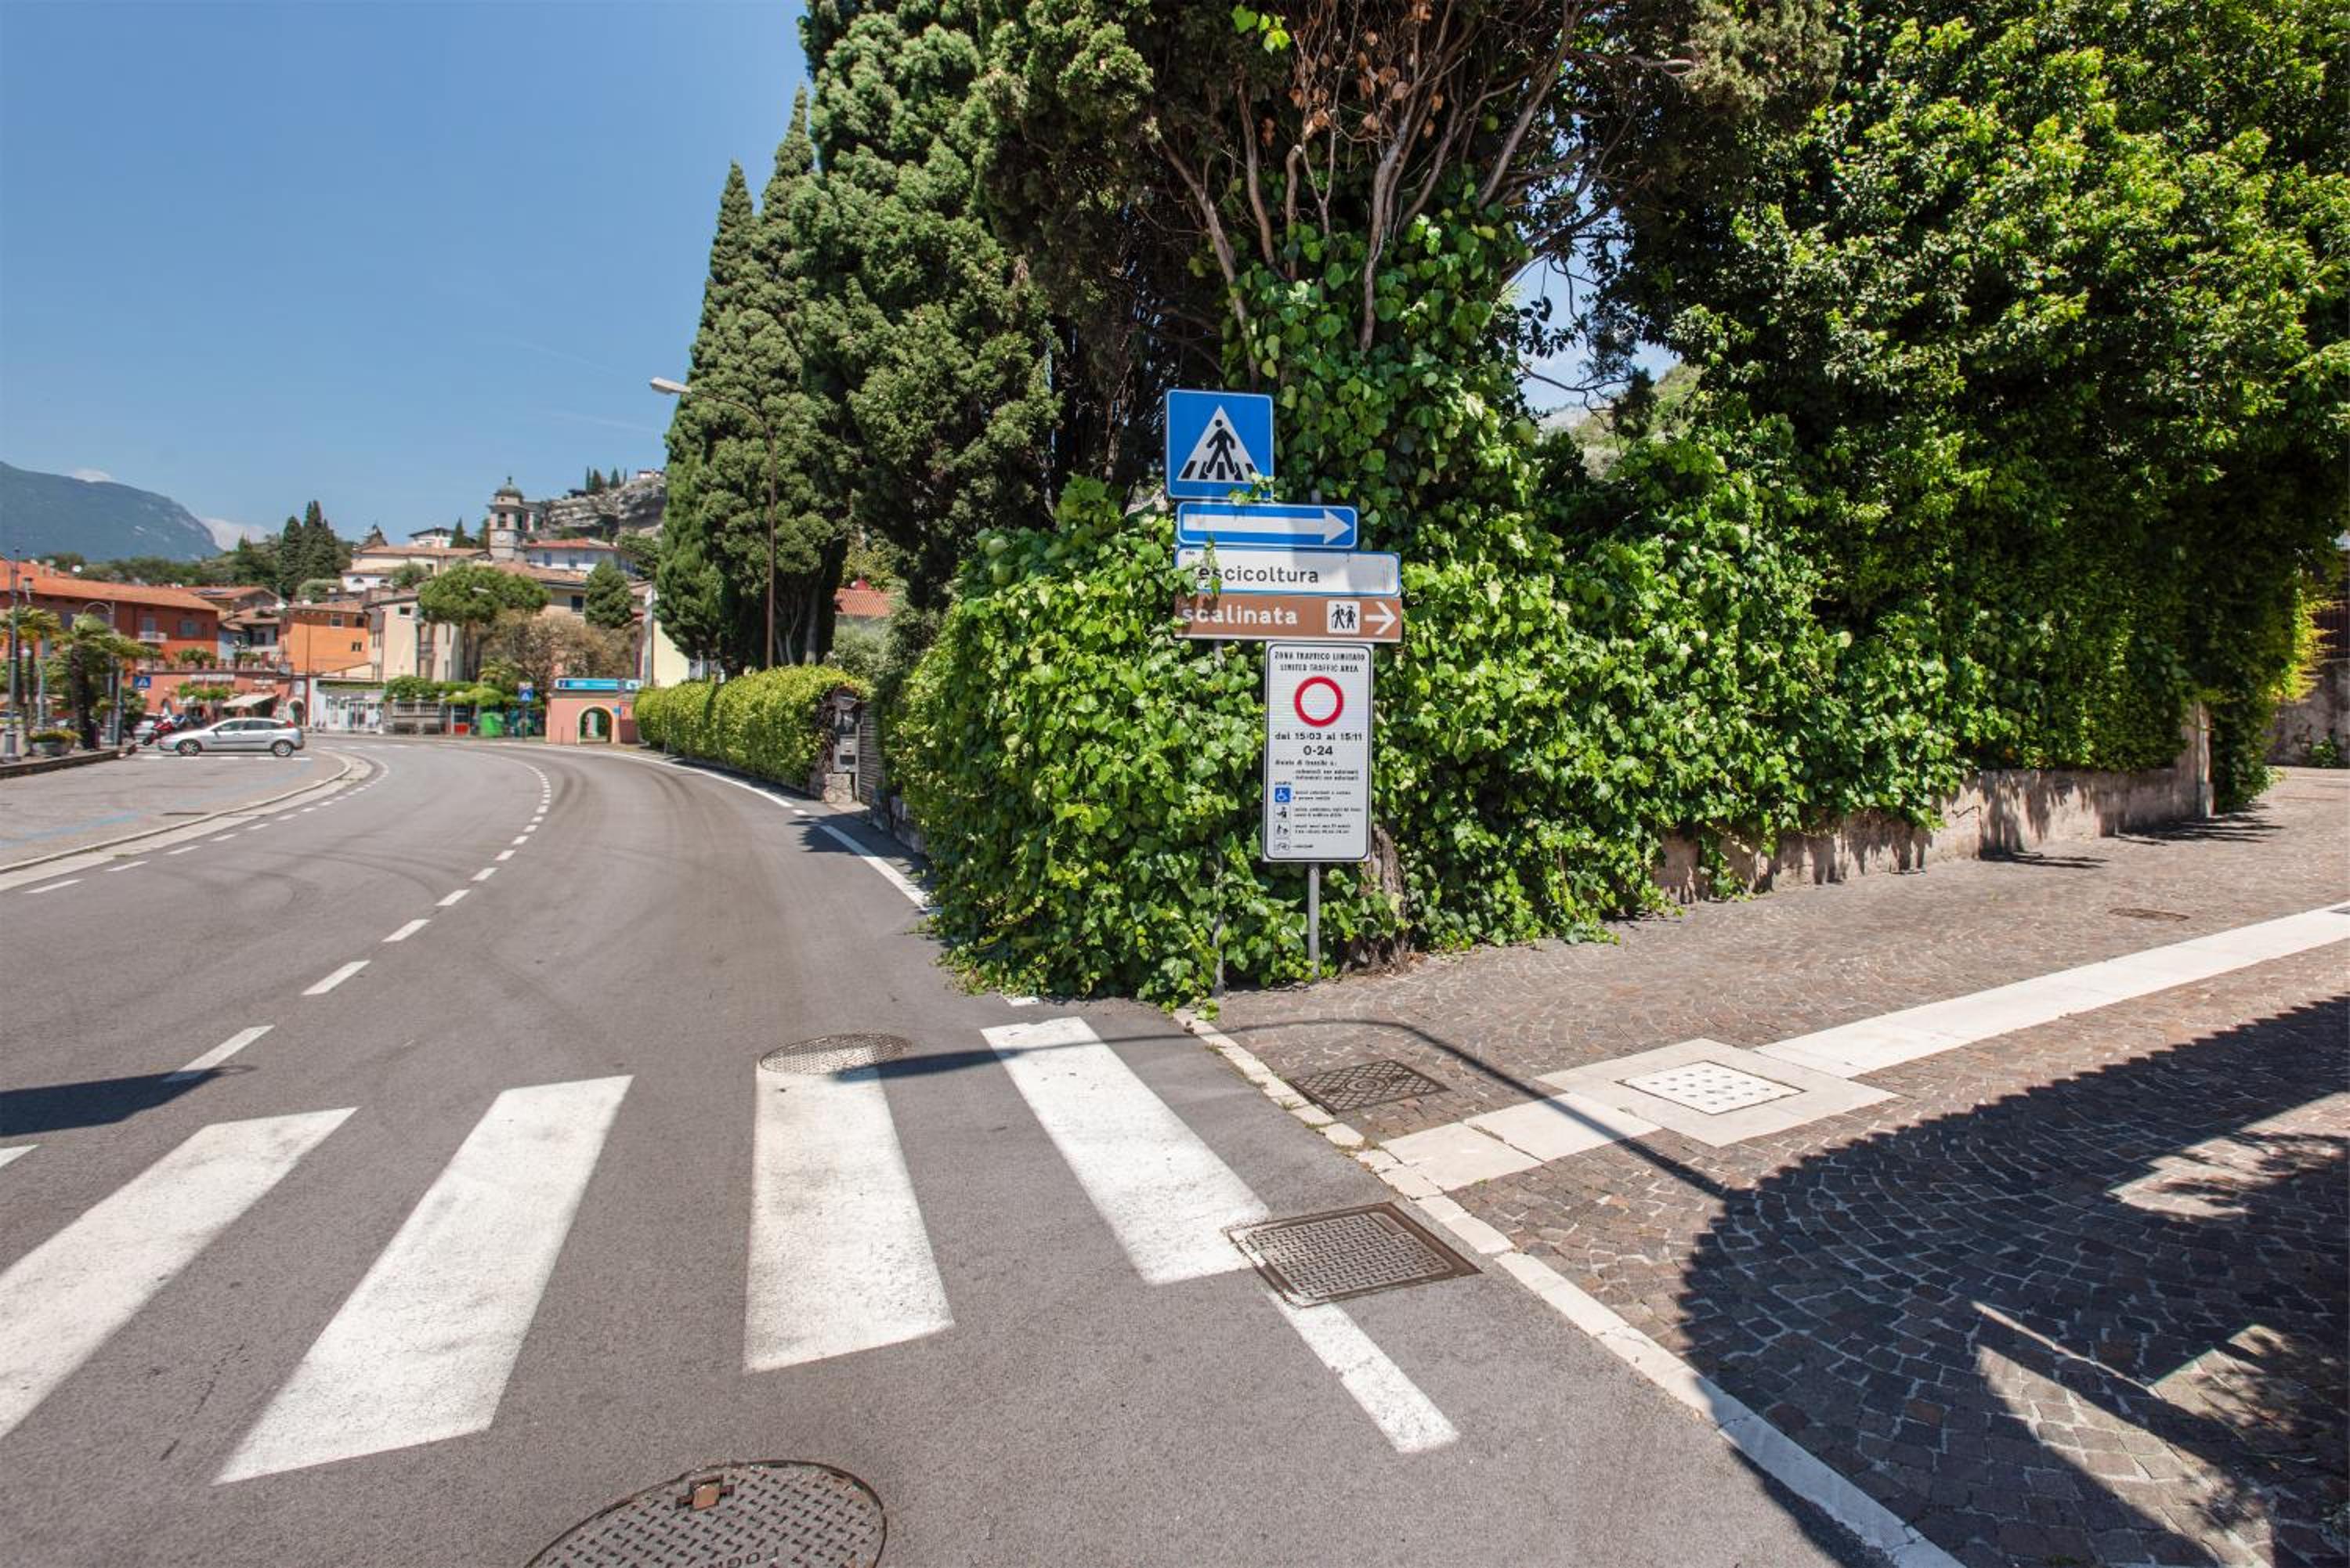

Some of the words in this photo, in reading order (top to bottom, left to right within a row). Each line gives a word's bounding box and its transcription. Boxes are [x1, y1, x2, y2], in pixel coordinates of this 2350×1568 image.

[1197, 565, 1319, 583] escicoltura
[1181, 603, 1298, 625] scalinata
[1274, 651, 1293, 660] ZONA
[1296, 652, 1331, 661] TRAFFICO
[1332, 652, 1365, 662] LIMITATO
[1274, 732, 1290, 740] dal
[1303, 745, 1333, 756] 0-24
